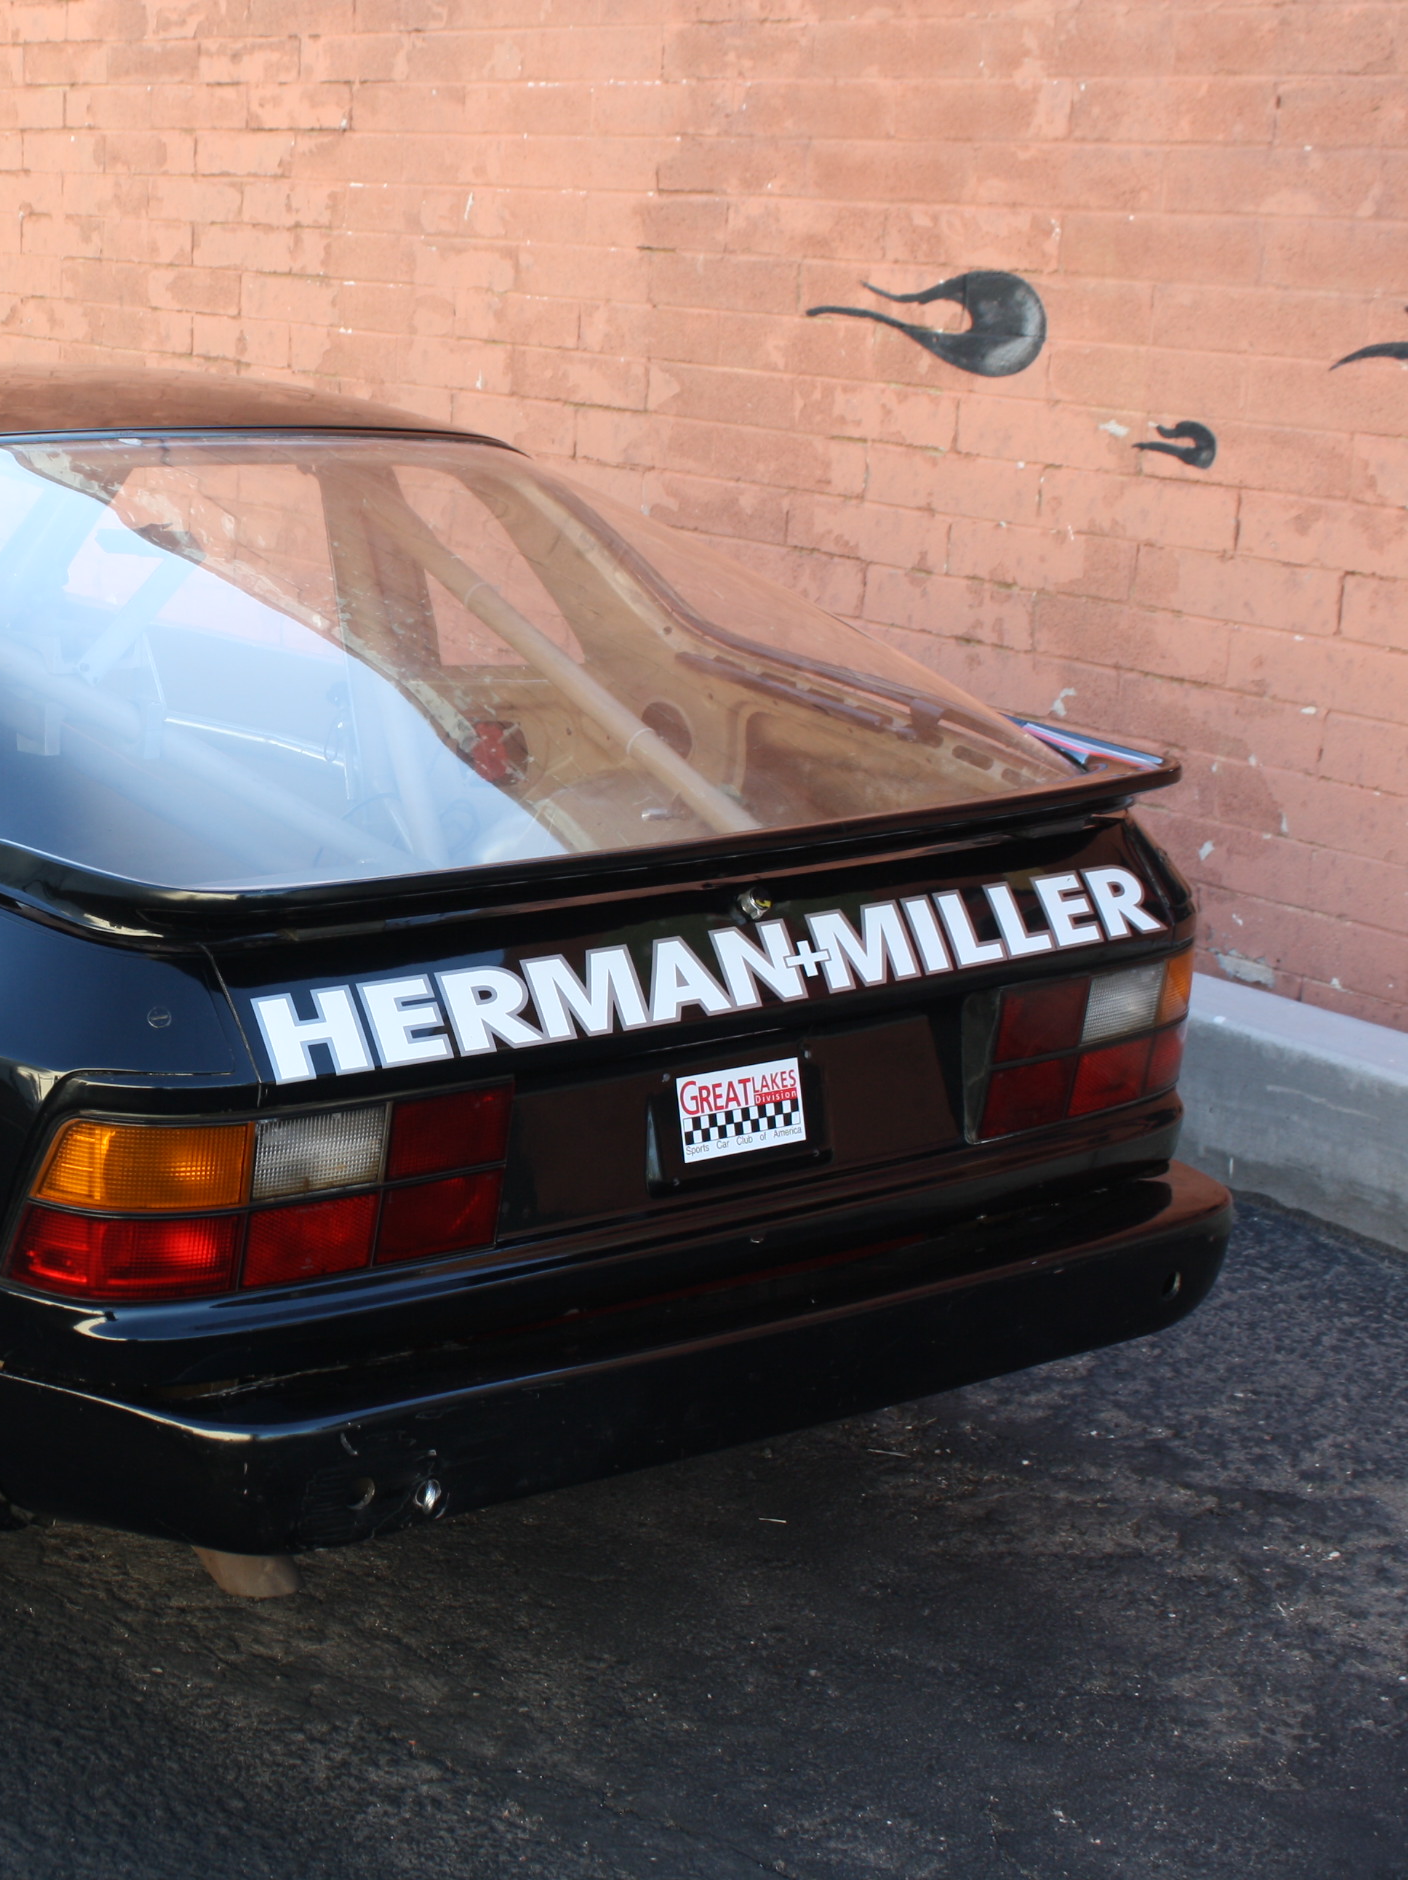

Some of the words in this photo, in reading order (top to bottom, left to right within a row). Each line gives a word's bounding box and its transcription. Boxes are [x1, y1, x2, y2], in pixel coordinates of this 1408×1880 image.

[680, 1078, 752, 1116] GREAT
[752, 1069, 797, 1094] LAKES
[755, 1090, 797, 1105] Division
[686, 1143, 710, 1156] Sports
[716, 1140, 730, 1150] Car
[736, 1136, 753, 1147] Club
[759, 1132, 767, 1142] of
[773, 1126, 802, 1139] America
